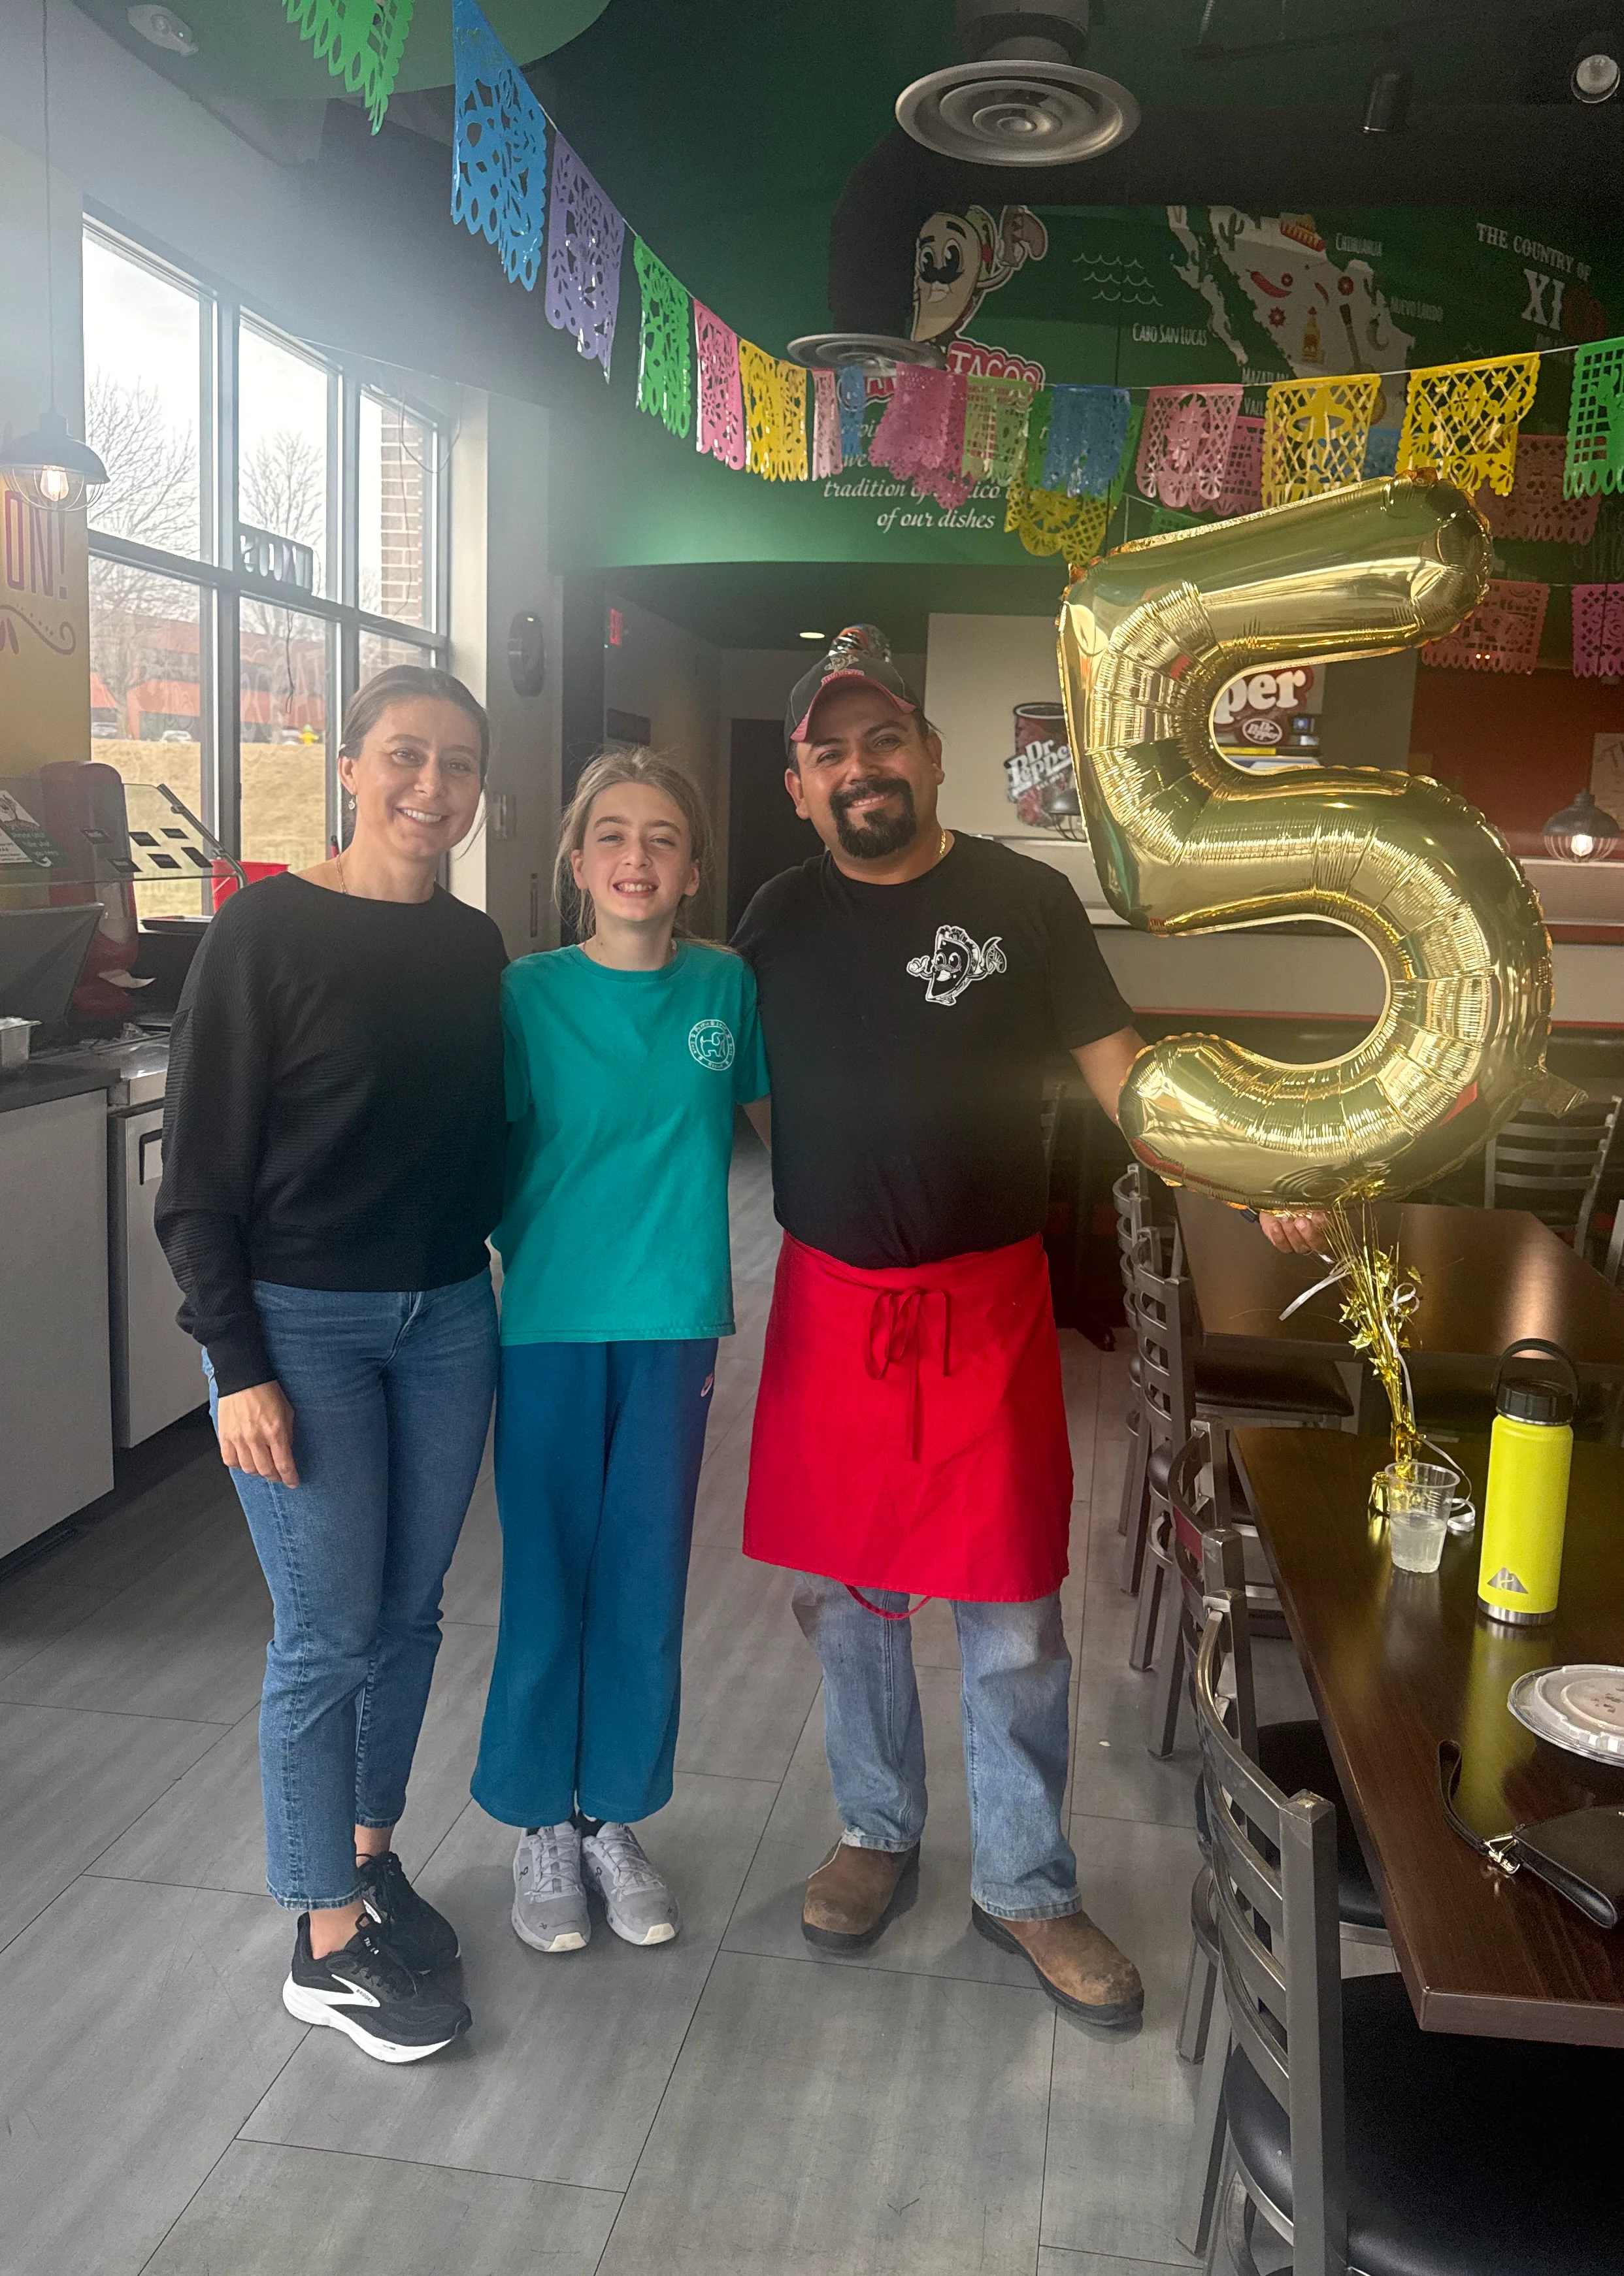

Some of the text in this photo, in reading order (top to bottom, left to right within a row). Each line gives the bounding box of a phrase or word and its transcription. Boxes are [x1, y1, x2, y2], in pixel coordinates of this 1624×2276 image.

[1476, 223, 1508, 249] THE
[1513, 235, 1574, 273] COUNTRY
[823, 478, 907, 497] tradition
[876, 507, 995, 533] of our dishes
[1213, 669, 1306, 724] per
[1025, 739, 1055, 763] Dr
[1008, 745, 1070, 789] Peppe
[356, 1988, 374, 2004] BROOKS
